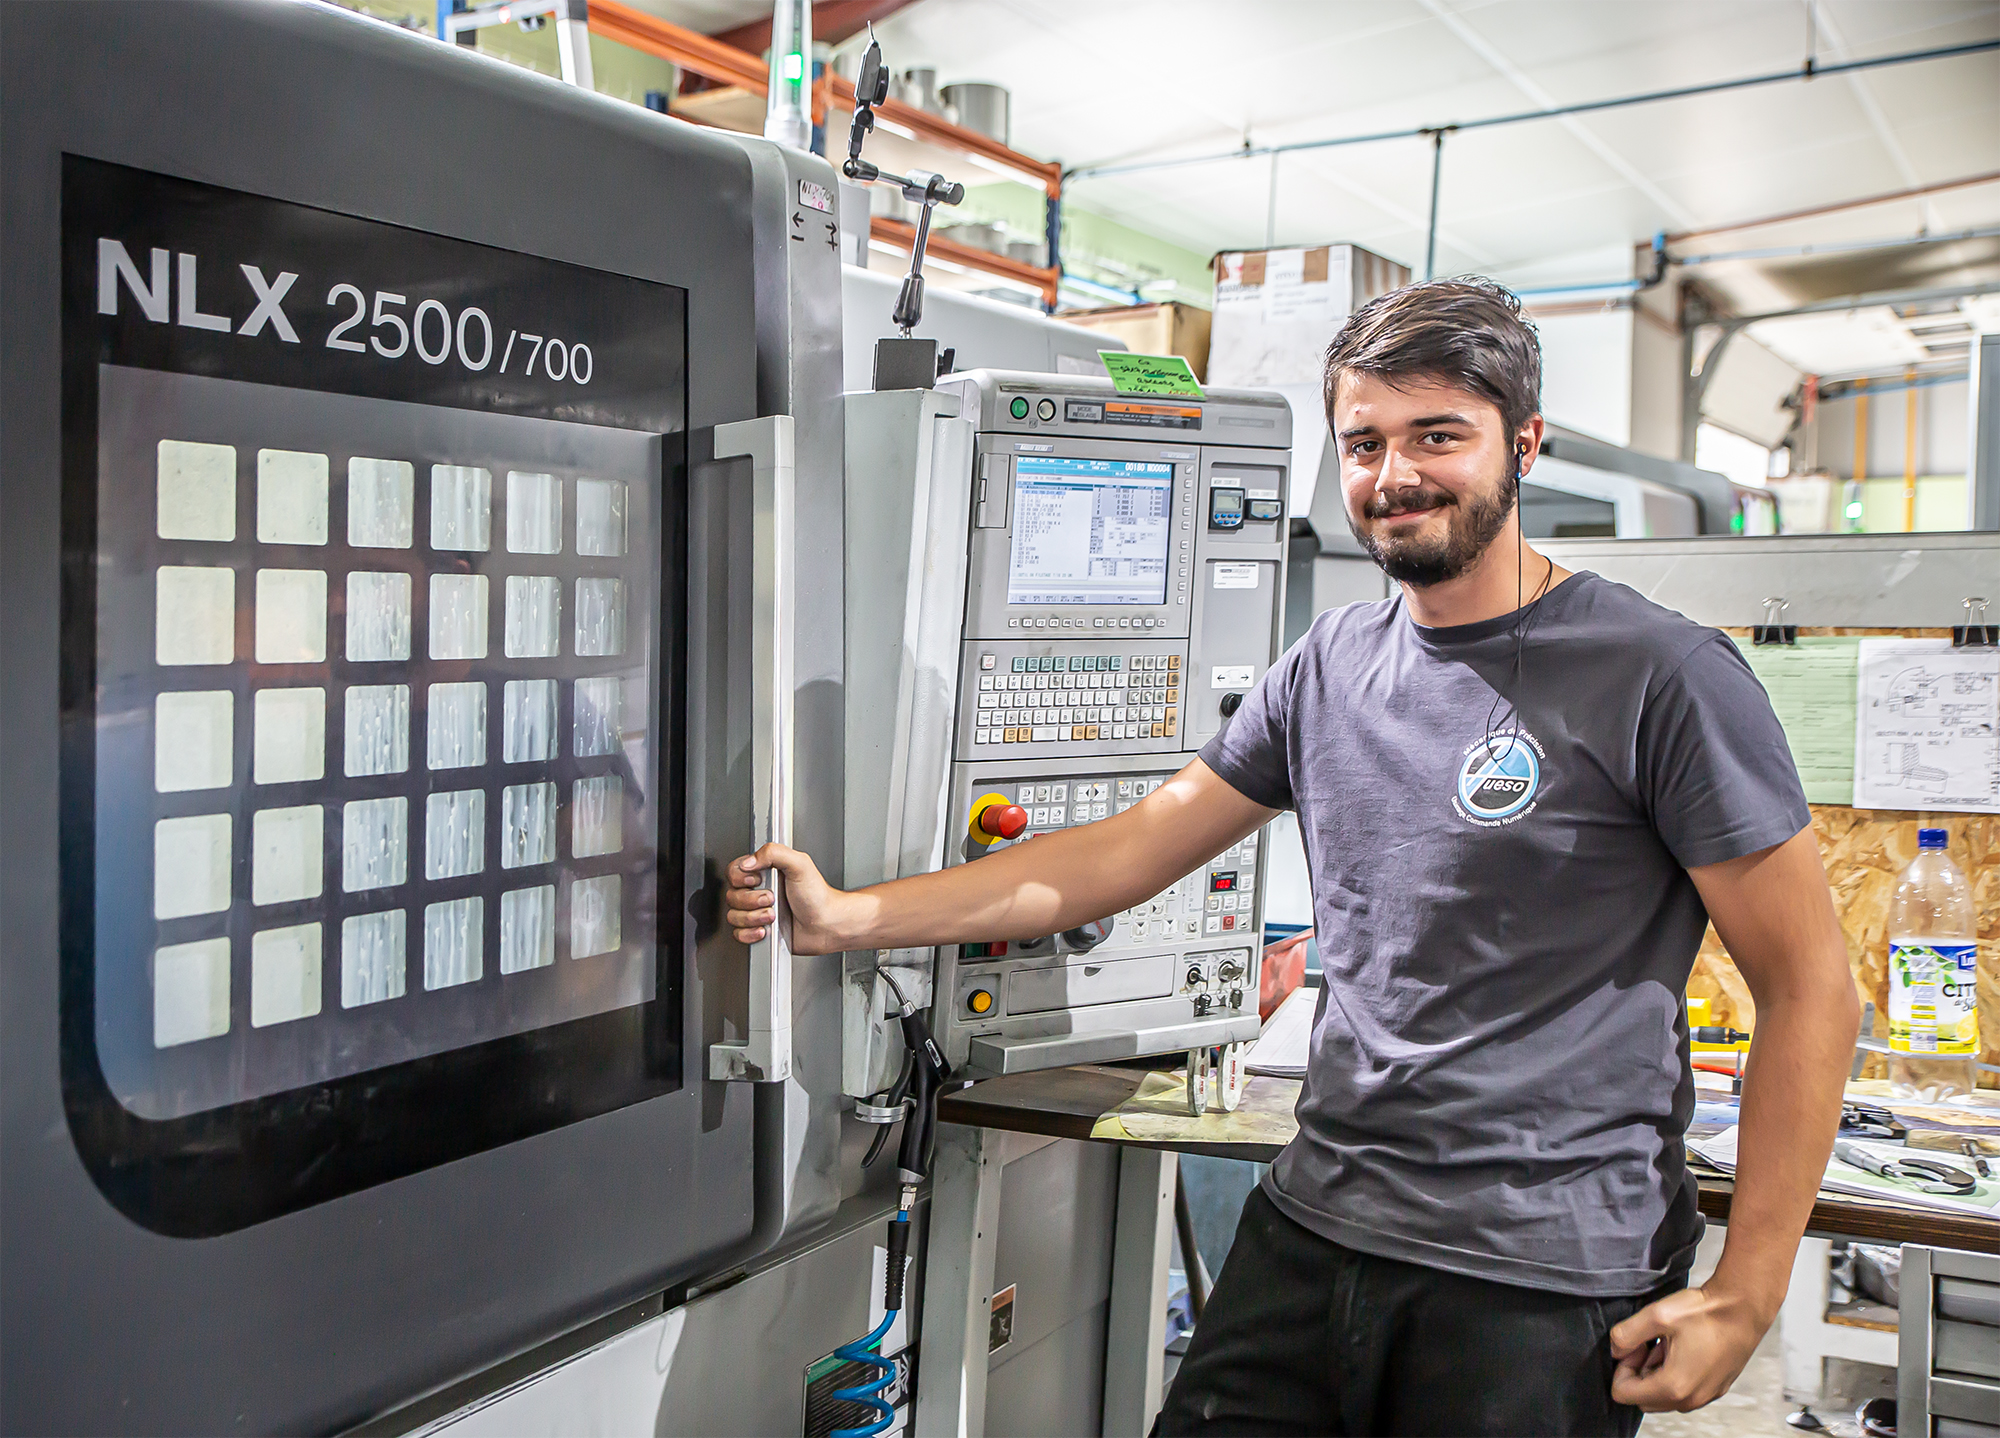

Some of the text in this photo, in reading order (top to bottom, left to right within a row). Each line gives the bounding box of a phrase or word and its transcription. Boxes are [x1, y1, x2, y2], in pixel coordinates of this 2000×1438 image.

[97, 238, 300, 343] NLX
[1518, 729, 1546, 760] Précision
[1466, 814, 1500, 827] Commande
[1942, 982, 1978, 998] CIT
